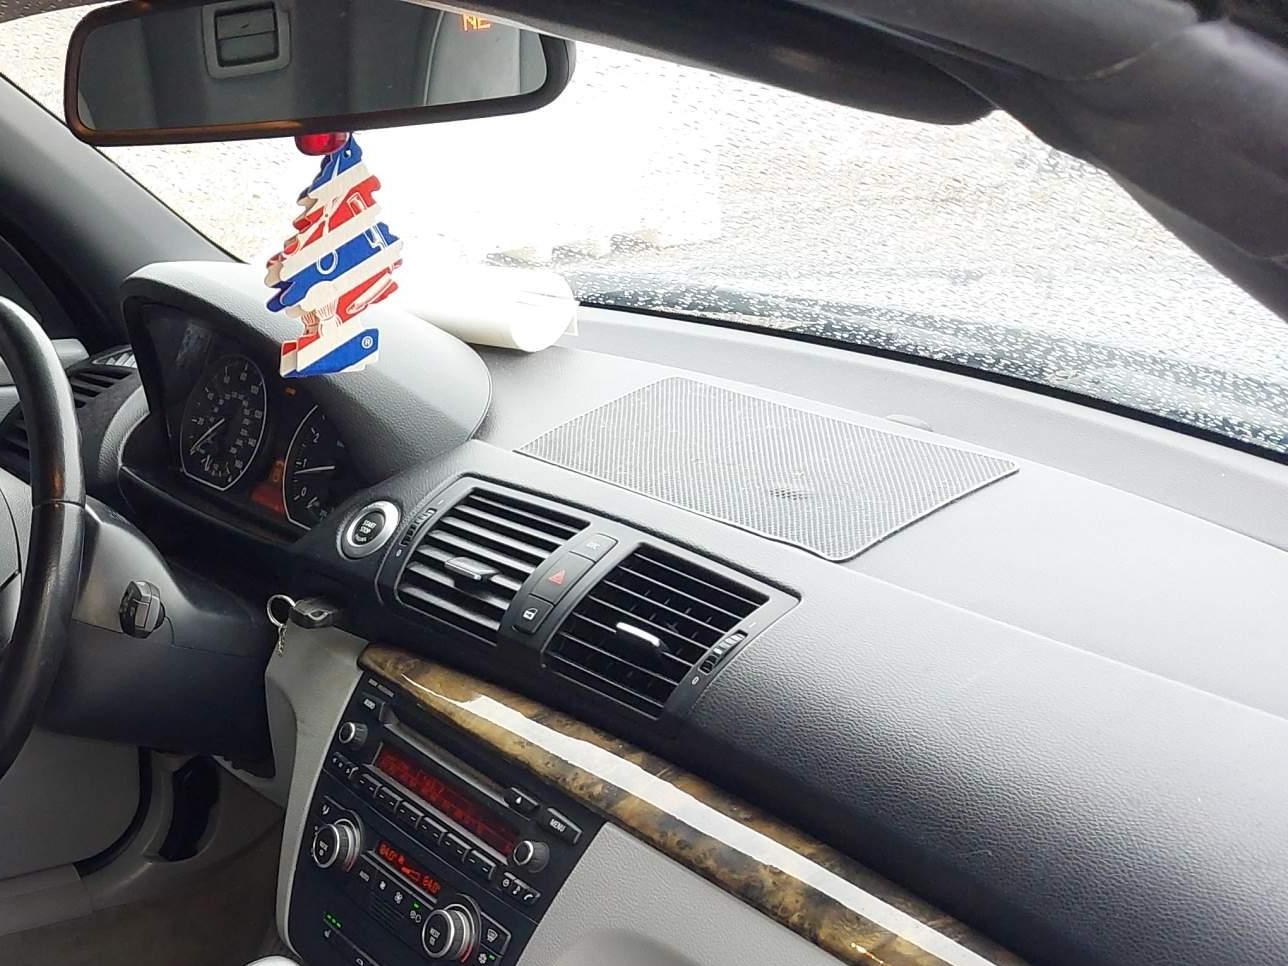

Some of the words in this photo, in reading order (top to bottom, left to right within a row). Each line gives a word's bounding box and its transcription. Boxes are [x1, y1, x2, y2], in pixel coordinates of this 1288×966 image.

[312, 432, 321, 444] 2
[300, 487, 307, 498] 0
[549, 818, 566, 834] MENU
